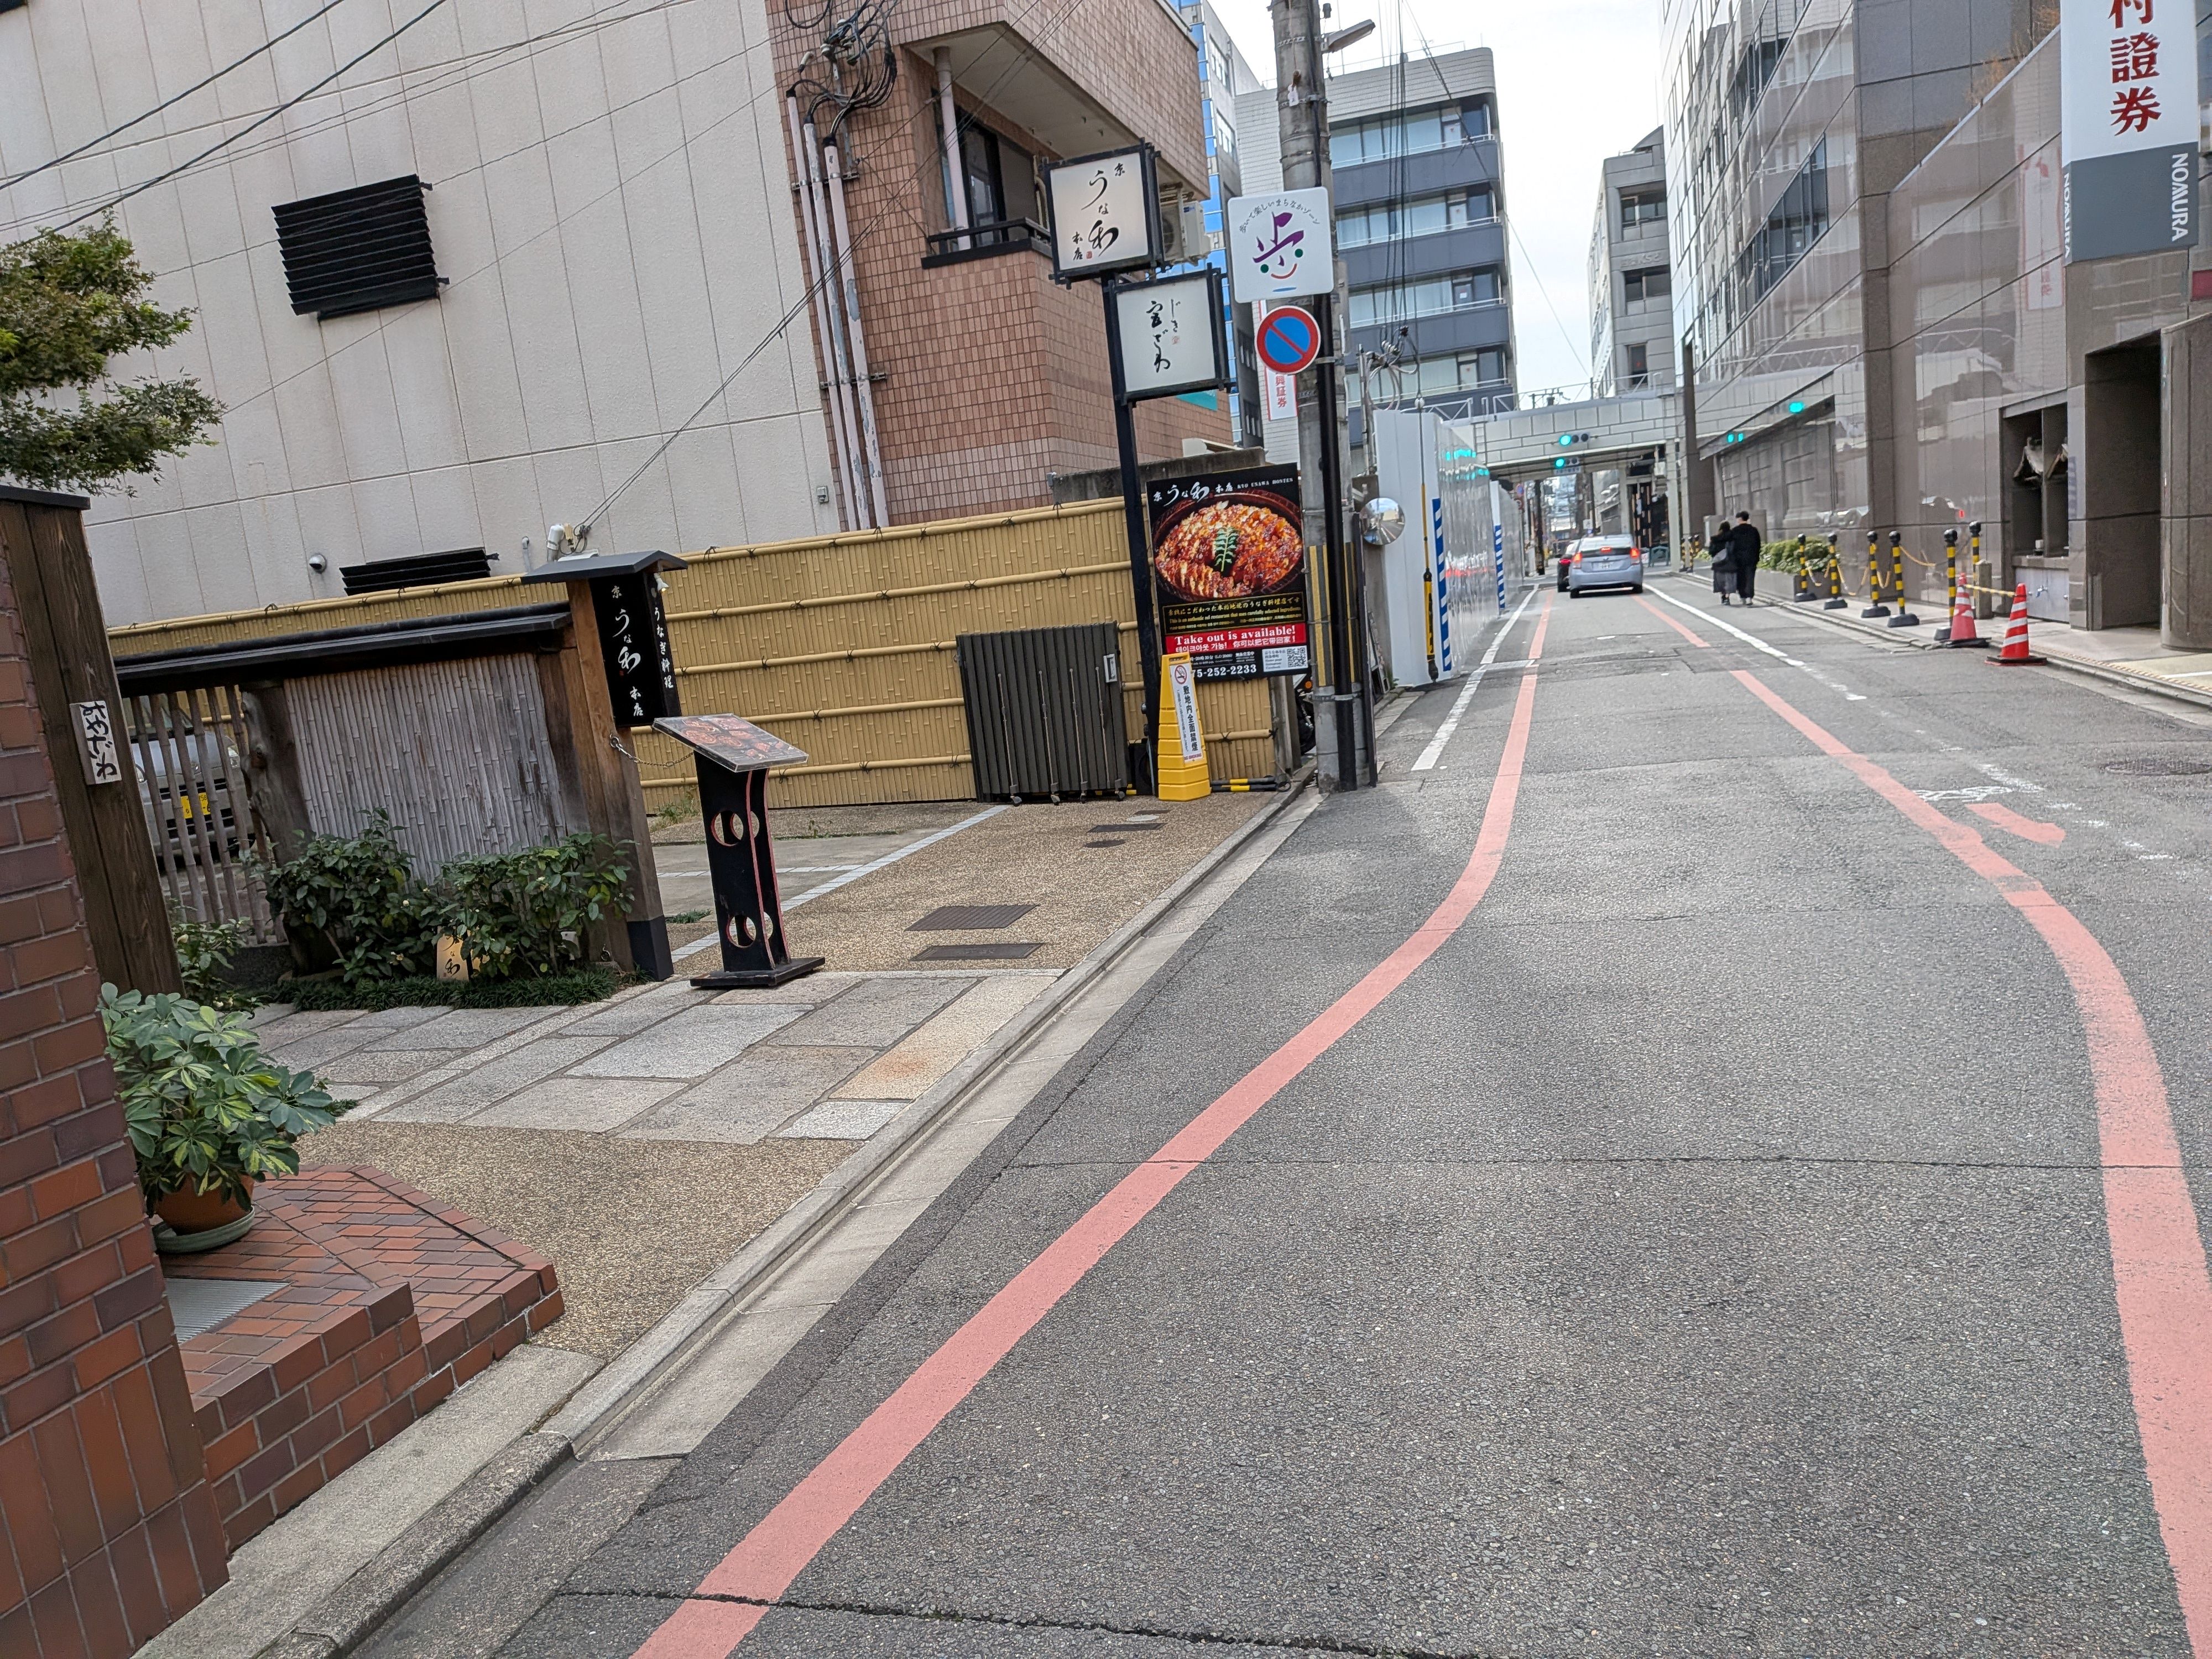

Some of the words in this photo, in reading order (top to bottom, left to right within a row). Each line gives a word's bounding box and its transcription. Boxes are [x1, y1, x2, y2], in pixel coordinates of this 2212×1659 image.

[1114, 163, 1125, 176] 京
[2171, 153, 2189, 242] NOMURA
[1072, 231, 1083, 261] 本店
[2063, 172, 2072, 259] NOMURA
[611, 585, 622, 599] 京
[629, 686, 644, 717] 本店
[654, 607, 674, 688] うなぎ料理
[1174, 635, 1203, 645] Take
[1207, 633, 1225, 642] out
[1228, 631, 1238, 640] is
[1244, 625, 1296, 638] available!
